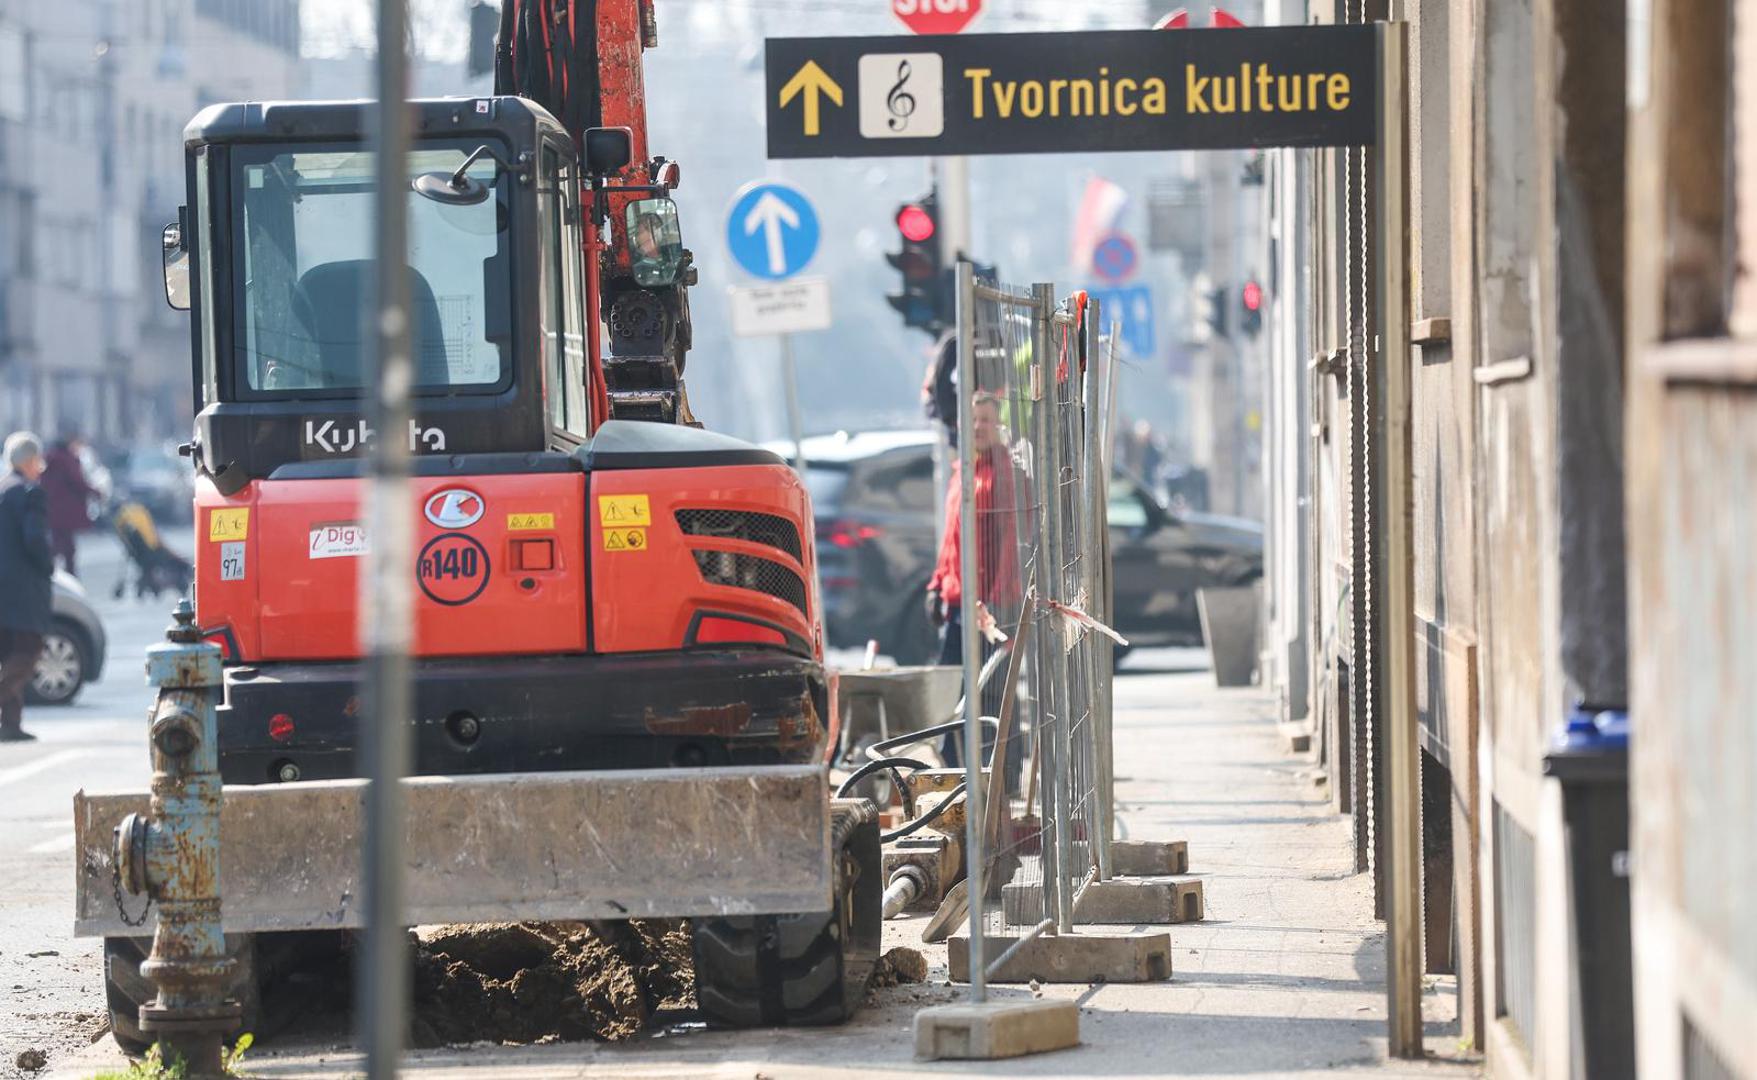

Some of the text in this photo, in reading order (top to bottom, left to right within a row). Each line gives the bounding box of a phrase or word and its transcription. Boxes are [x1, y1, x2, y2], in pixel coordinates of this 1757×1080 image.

[963, 62, 1350, 119] Tvornica kulture
[305, 419, 446, 453] Kubta
